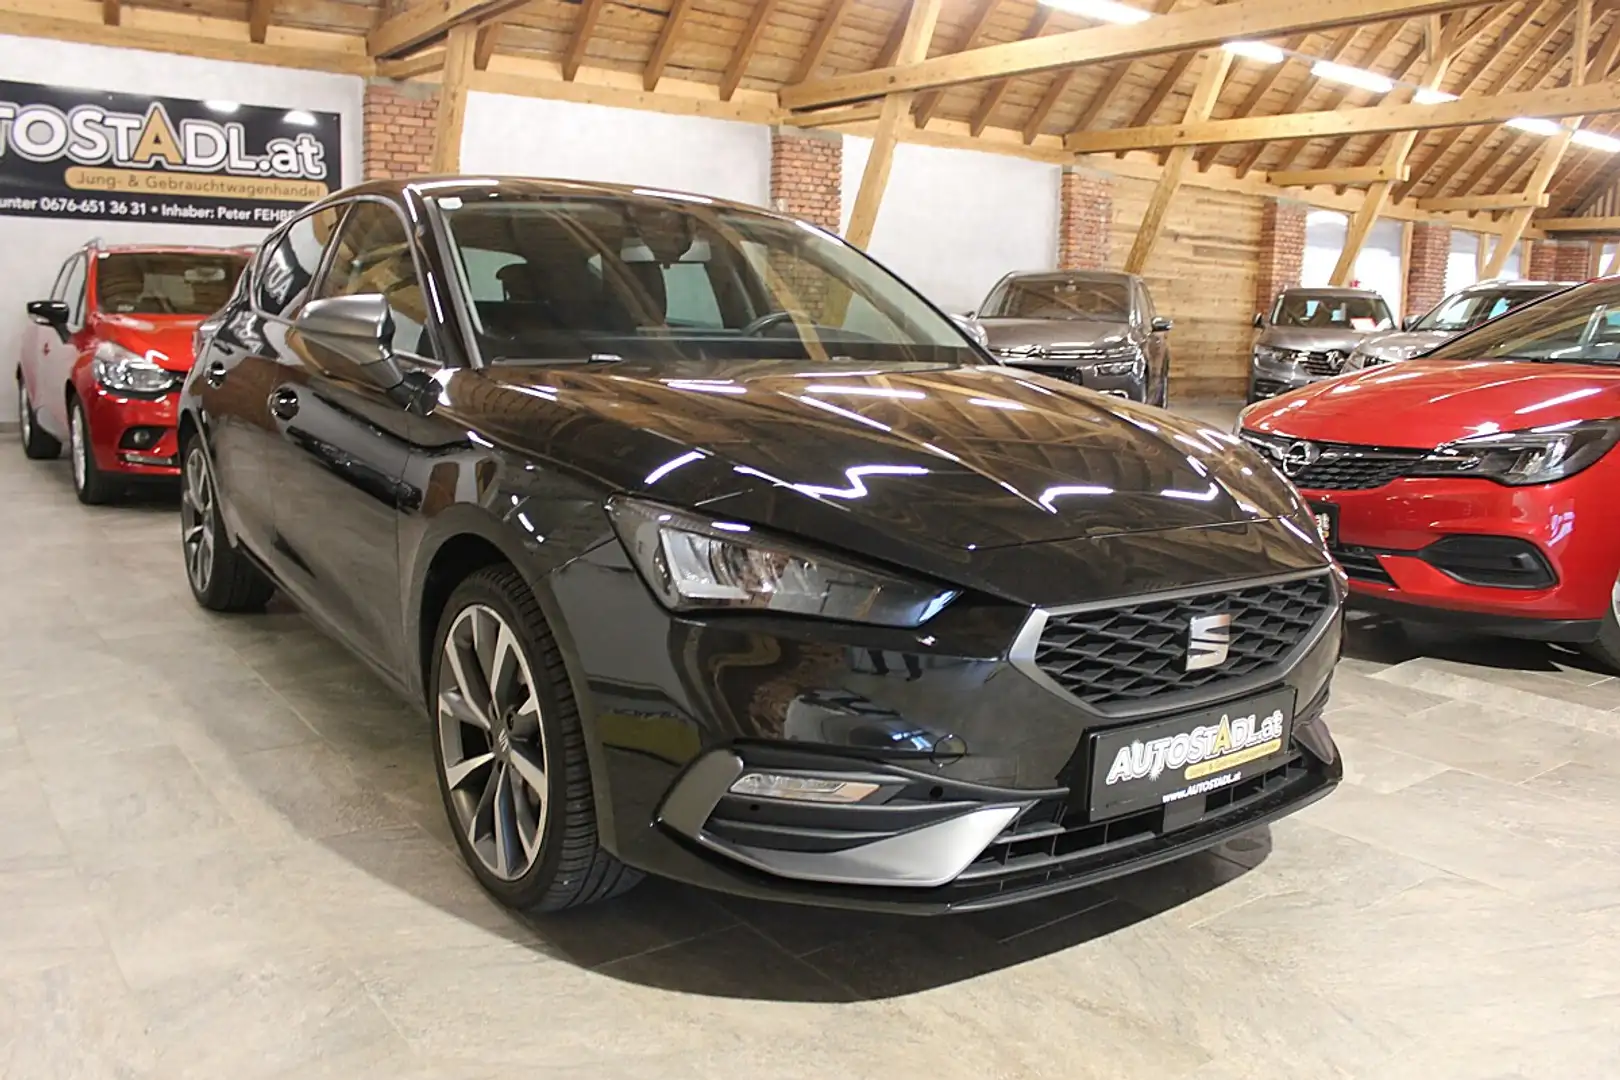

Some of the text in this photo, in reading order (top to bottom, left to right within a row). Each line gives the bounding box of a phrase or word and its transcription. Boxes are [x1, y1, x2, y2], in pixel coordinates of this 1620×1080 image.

[76, 171, 321, 198] Jung- & Gebrauchtwagenhandel
[40, 197, 105, 214] 0676-651
[109, 200, 128, 215] 36
[130, 201, 146, 216] 31
[161, 203, 215, 219] Inhaber:
[217, 206, 251, 220] Peter
[1106, 709, 1283, 785] AUTOSTADL.at
[1162, 771, 1242, 803] www.AUTOSTADL.at
